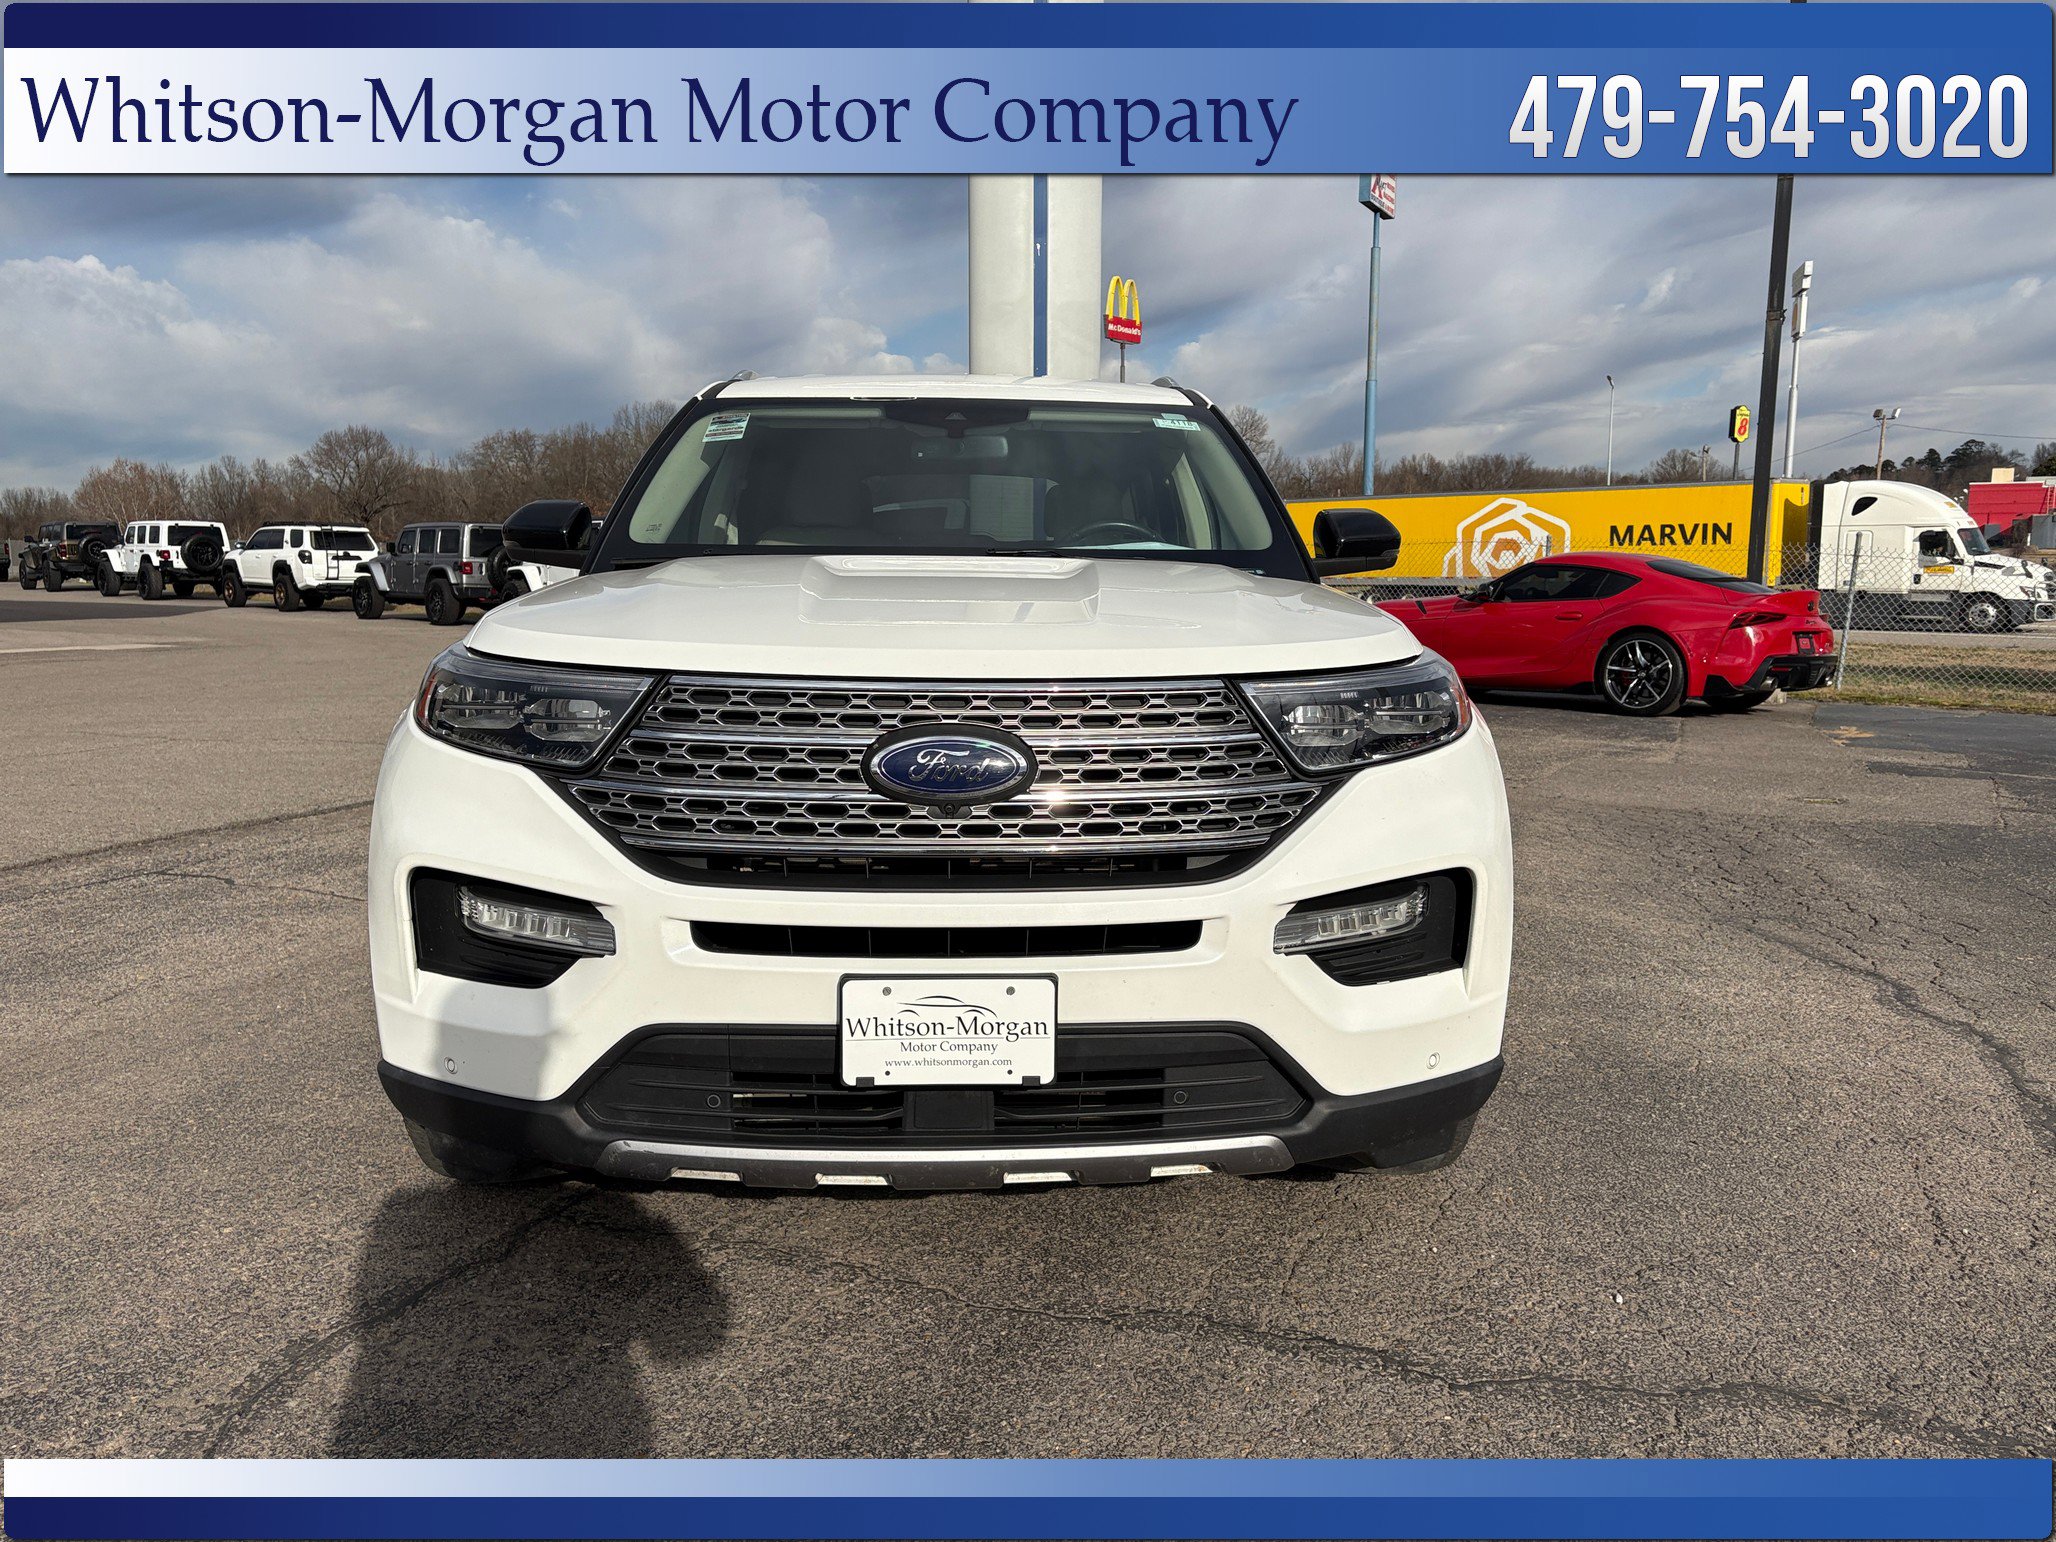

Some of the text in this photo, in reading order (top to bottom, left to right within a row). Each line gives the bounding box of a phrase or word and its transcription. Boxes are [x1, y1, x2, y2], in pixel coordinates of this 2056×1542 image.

[1107, 323, 1141, 336] McDonald's
[1609, 522, 1732, 546] MARVIN
[908, 749, 990, 781] Ford
[846, 1016, 1048, 1042] Whitson-Morgan
[900, 1041, 998, 1054] Motor Company
[885, 1057, 1012, 1068] www.whitsonmorgan.com
